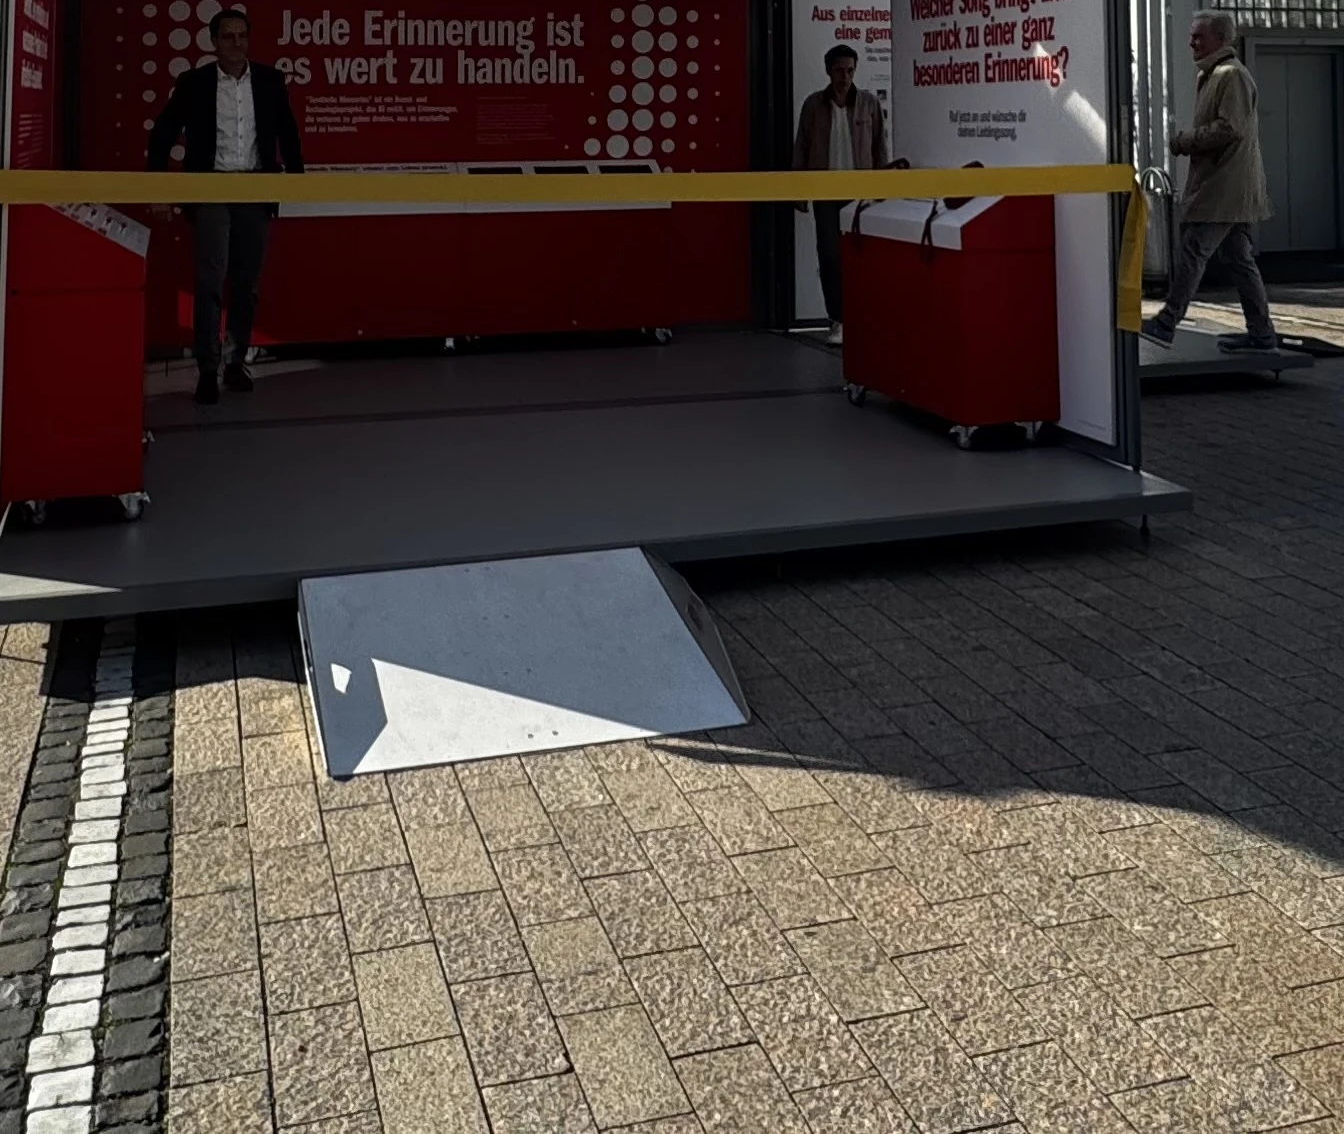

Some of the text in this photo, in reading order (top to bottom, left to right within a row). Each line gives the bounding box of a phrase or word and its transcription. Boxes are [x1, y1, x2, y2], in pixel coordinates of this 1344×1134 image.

[277, 9, 585, 54] Jede Erinnerung ist
[812, 5, 892, 22] Aus einzelne
[835, 24, 861, 40] eine
[923, 15, 1055, 53] zurück zu einer ganz
[275, 50, 585, 85] es wert zu handeln.
[912, 46, 1070, 88] besonderen Erinnerung?
